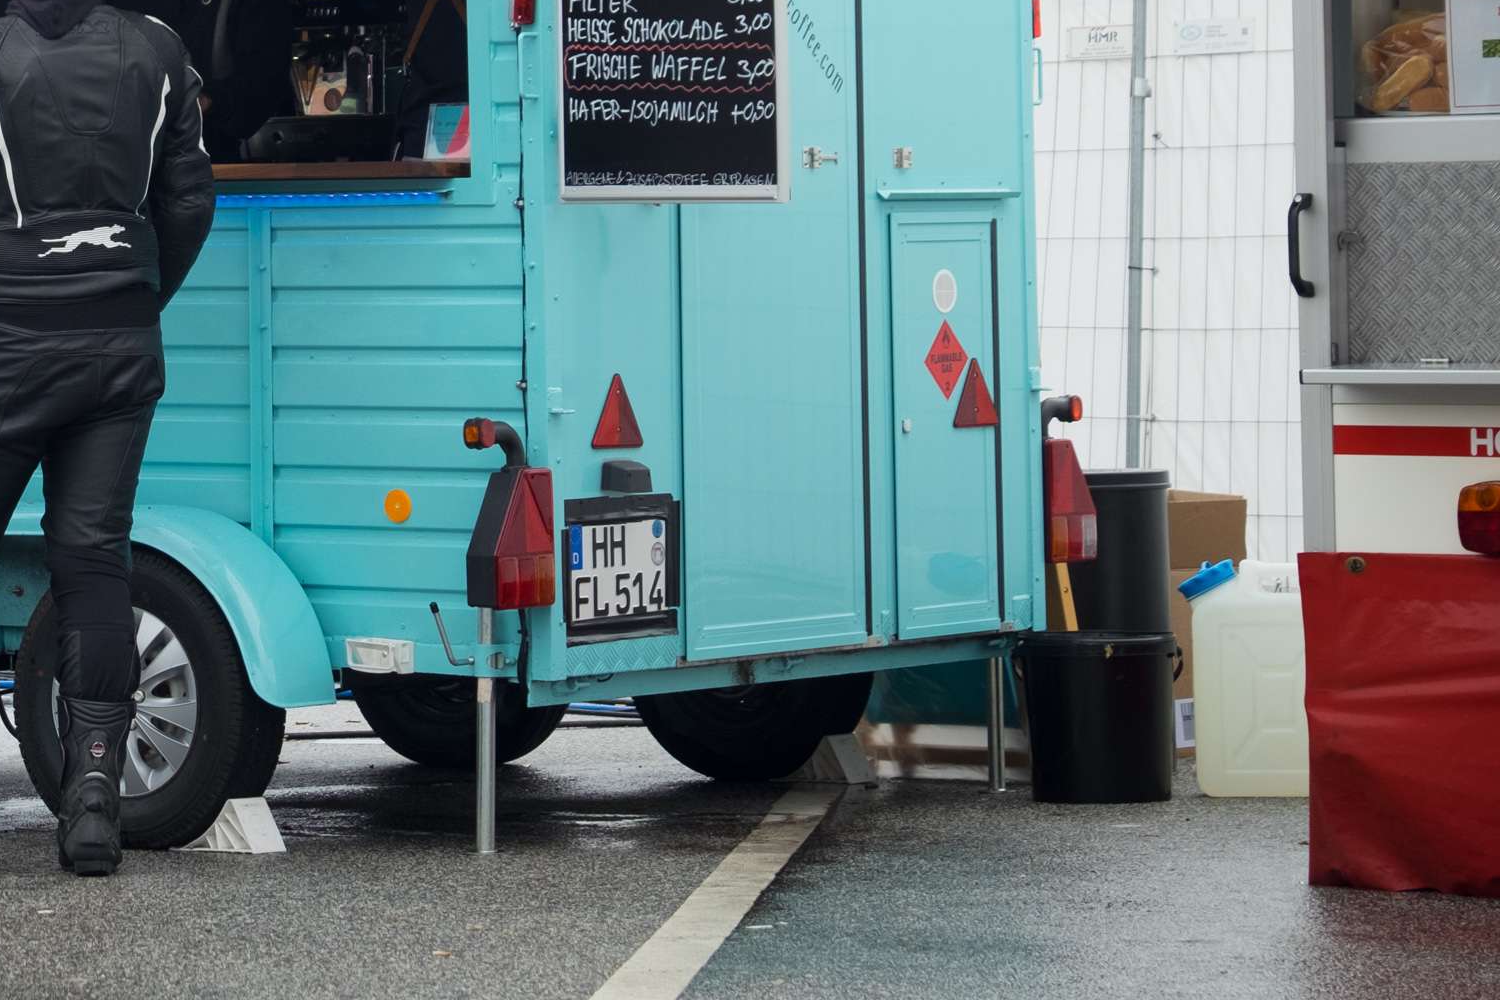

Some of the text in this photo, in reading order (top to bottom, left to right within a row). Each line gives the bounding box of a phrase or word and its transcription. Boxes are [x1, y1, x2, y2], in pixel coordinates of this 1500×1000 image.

[567, 12, 773, 46] HEISSE SCHOKOLADE 3,00
[567, 50, 775, 85] FRISCHE WAFFEL 3,00
[572, 551, 580, 565] D
[592, 524, 626, 569] HH
[575, 570, 664, 619] FL 514
